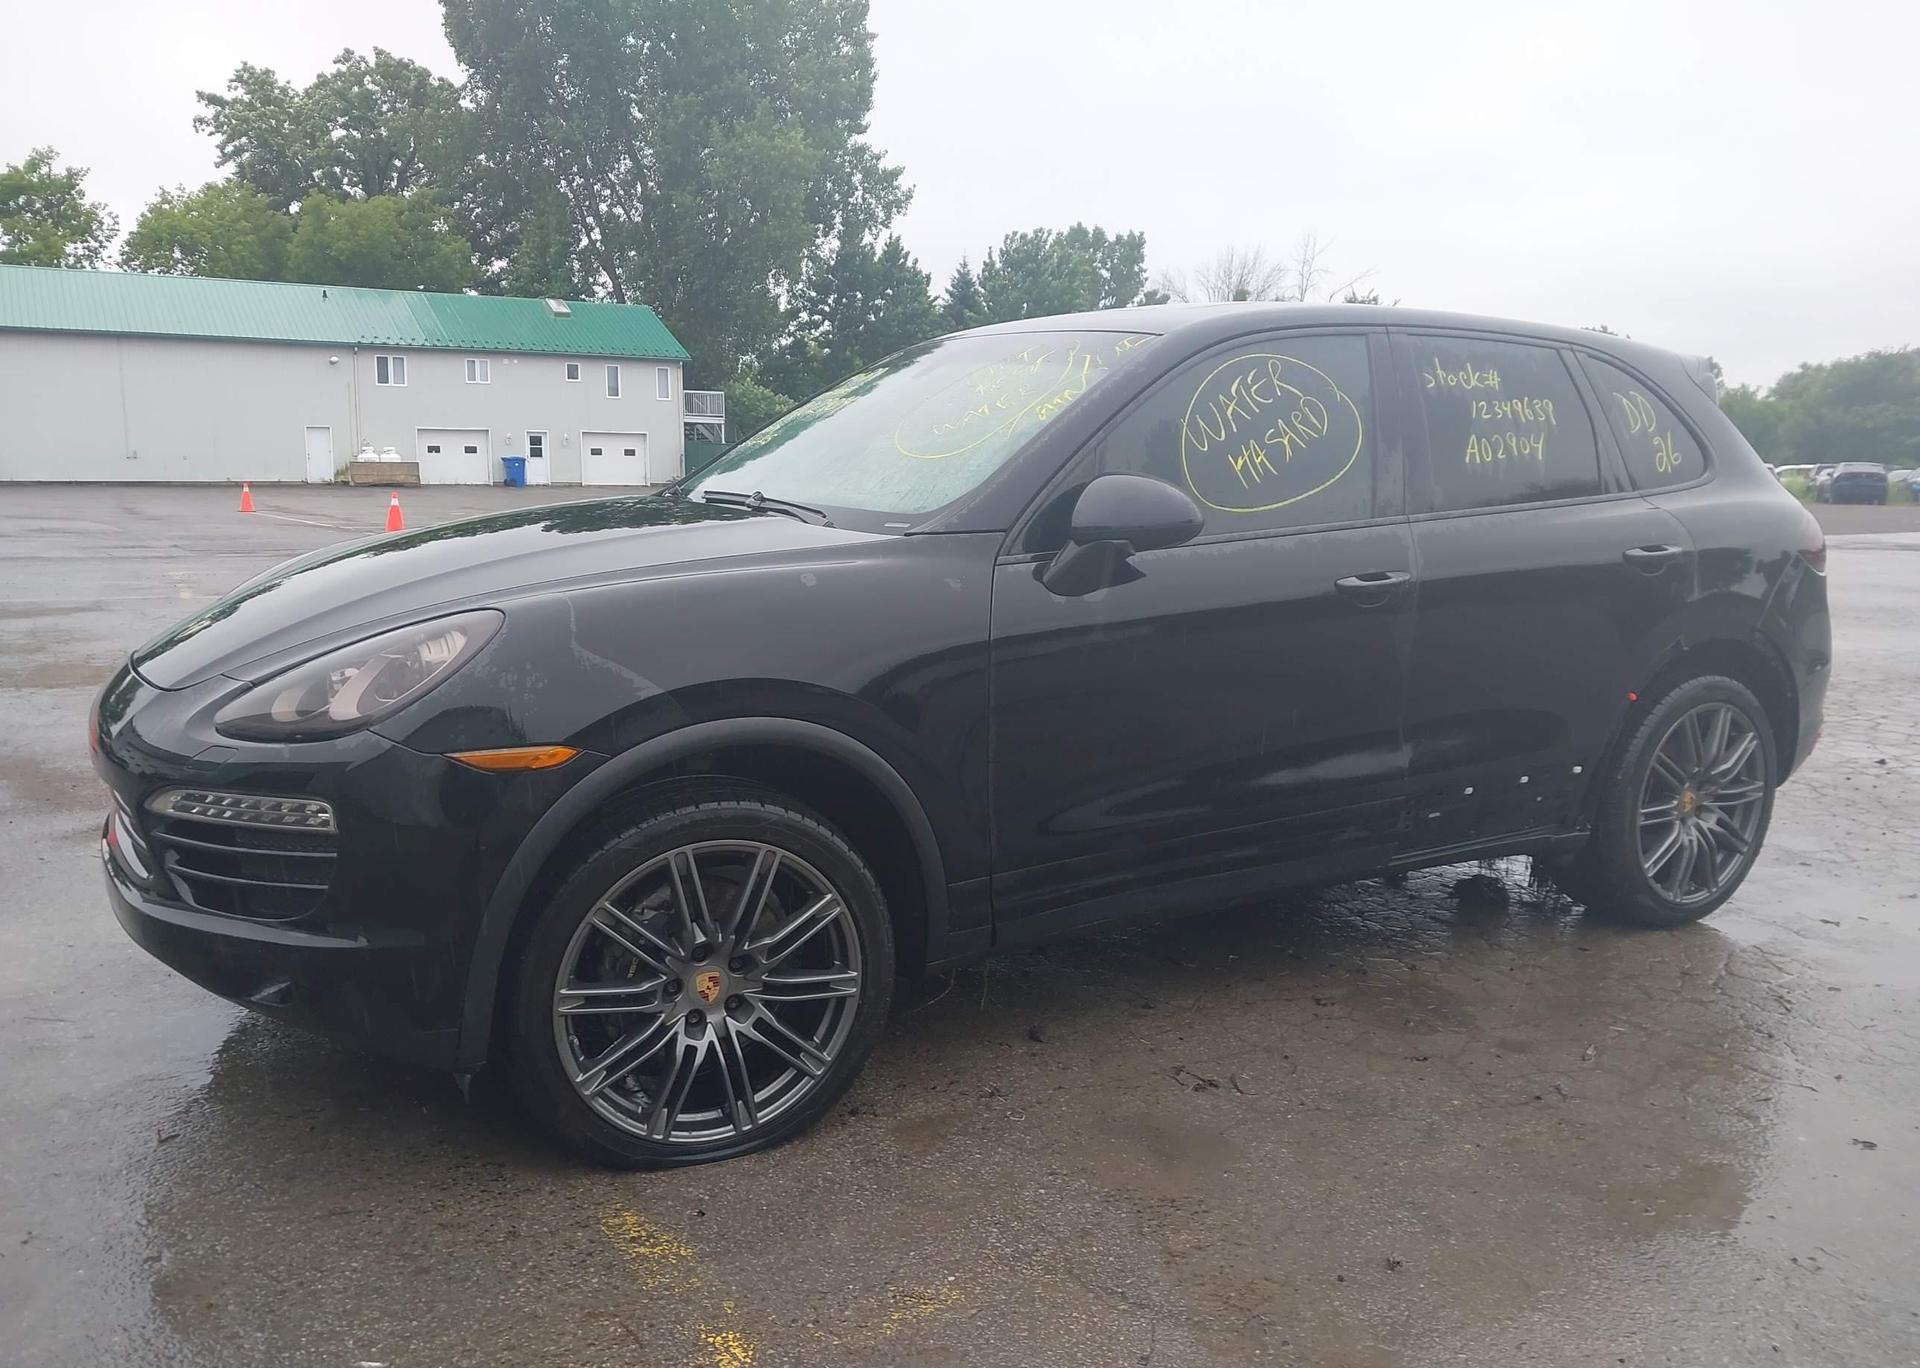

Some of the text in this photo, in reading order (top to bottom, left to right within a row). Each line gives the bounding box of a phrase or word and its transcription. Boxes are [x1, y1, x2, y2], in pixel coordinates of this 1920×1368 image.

[1181, 359, 1304, 451] WATER
[1228, 396, 1328, 488] HASARD
[1472, 397, 1556, 424] 12349639
